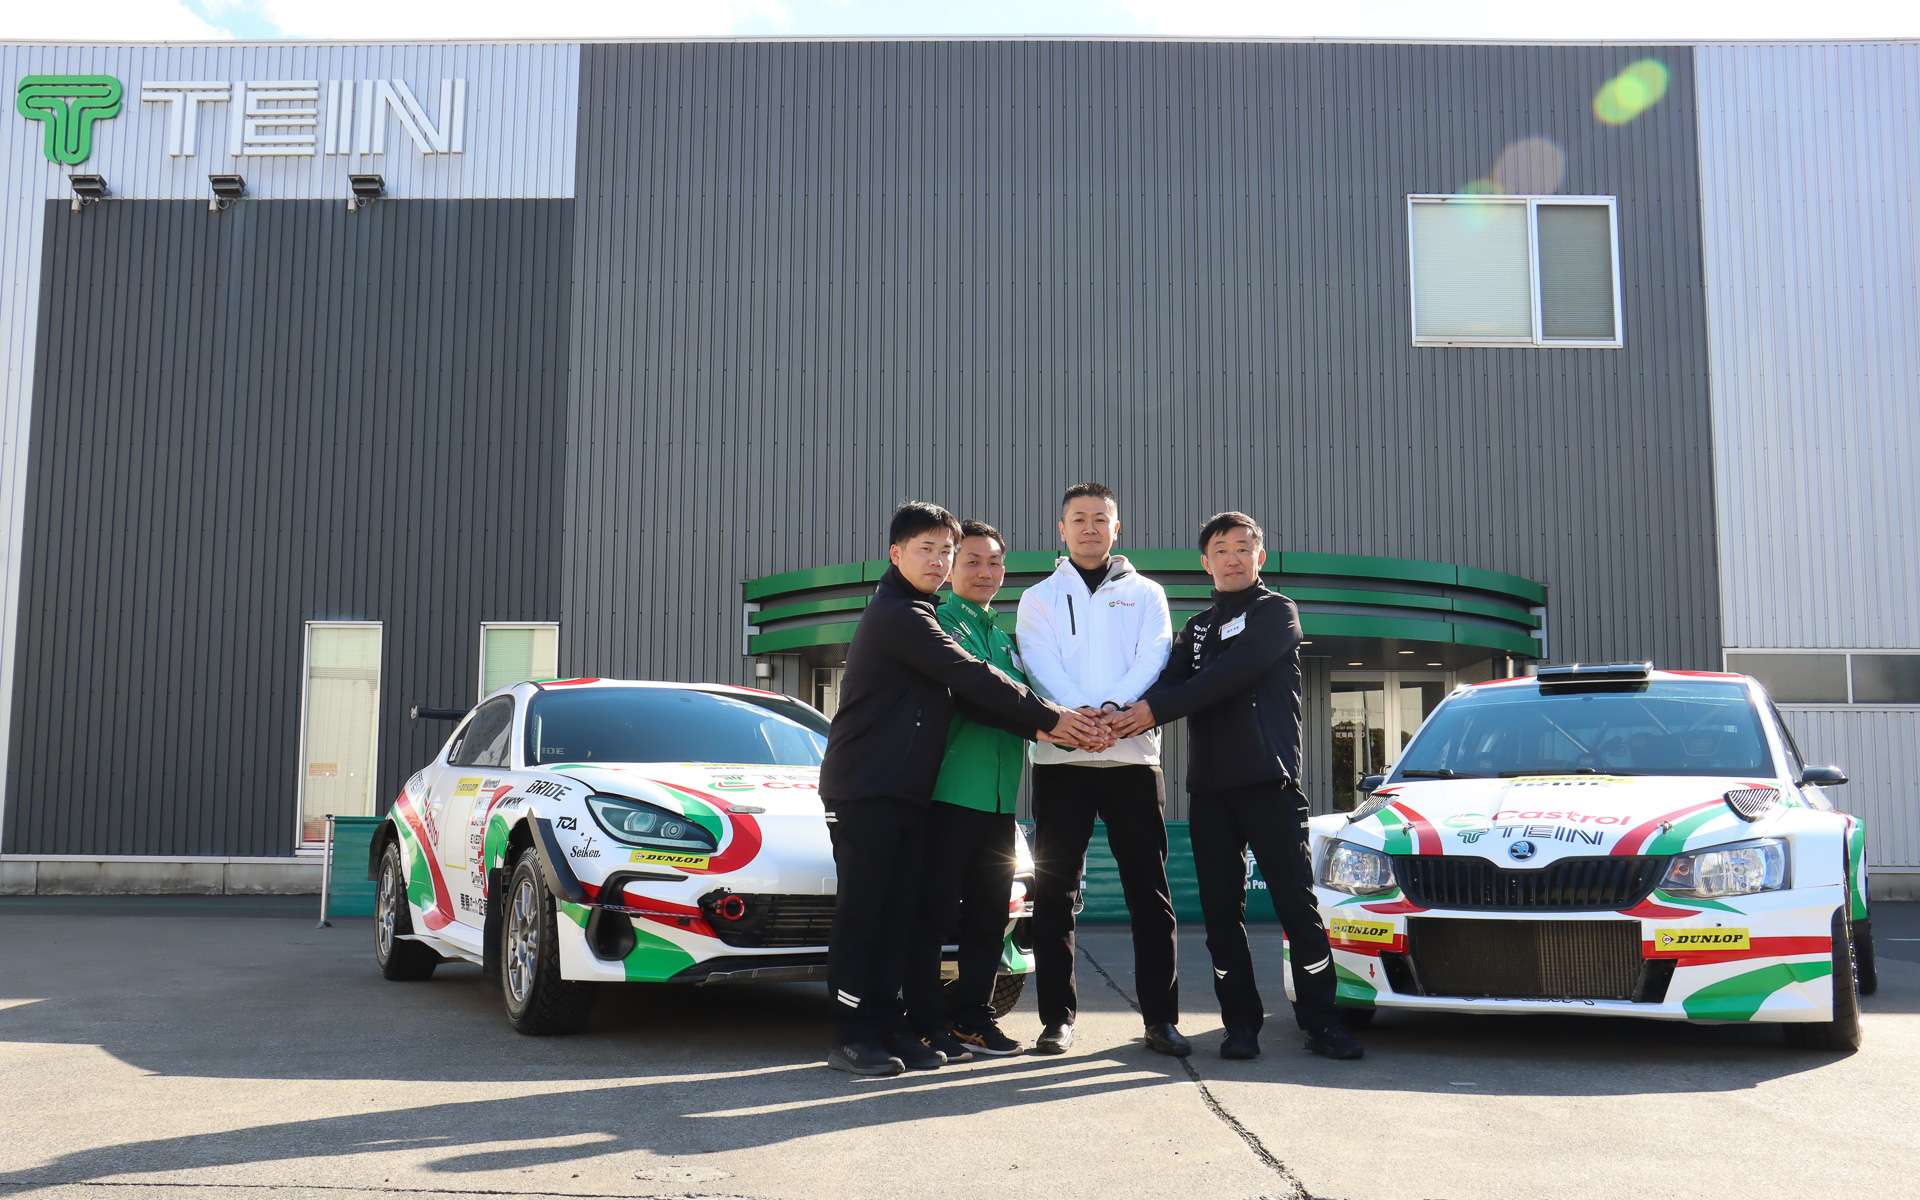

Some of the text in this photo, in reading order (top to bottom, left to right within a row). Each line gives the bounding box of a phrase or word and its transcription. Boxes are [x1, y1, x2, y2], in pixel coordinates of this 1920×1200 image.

[142, 78, 466, 158] TEIN
[525, 779, 572, 801] BRIDE
[1491, 809, 1632, 827] Castrol
[1495, 824, 1604, 846] TEIN
[570, 837, 601, 858] Seiken
[645, 854, 704, 864] DUNLOP
[1340, 925, 1389, 937] DUNLOP
[1676, 934, 1744, 944] DUNLOP
